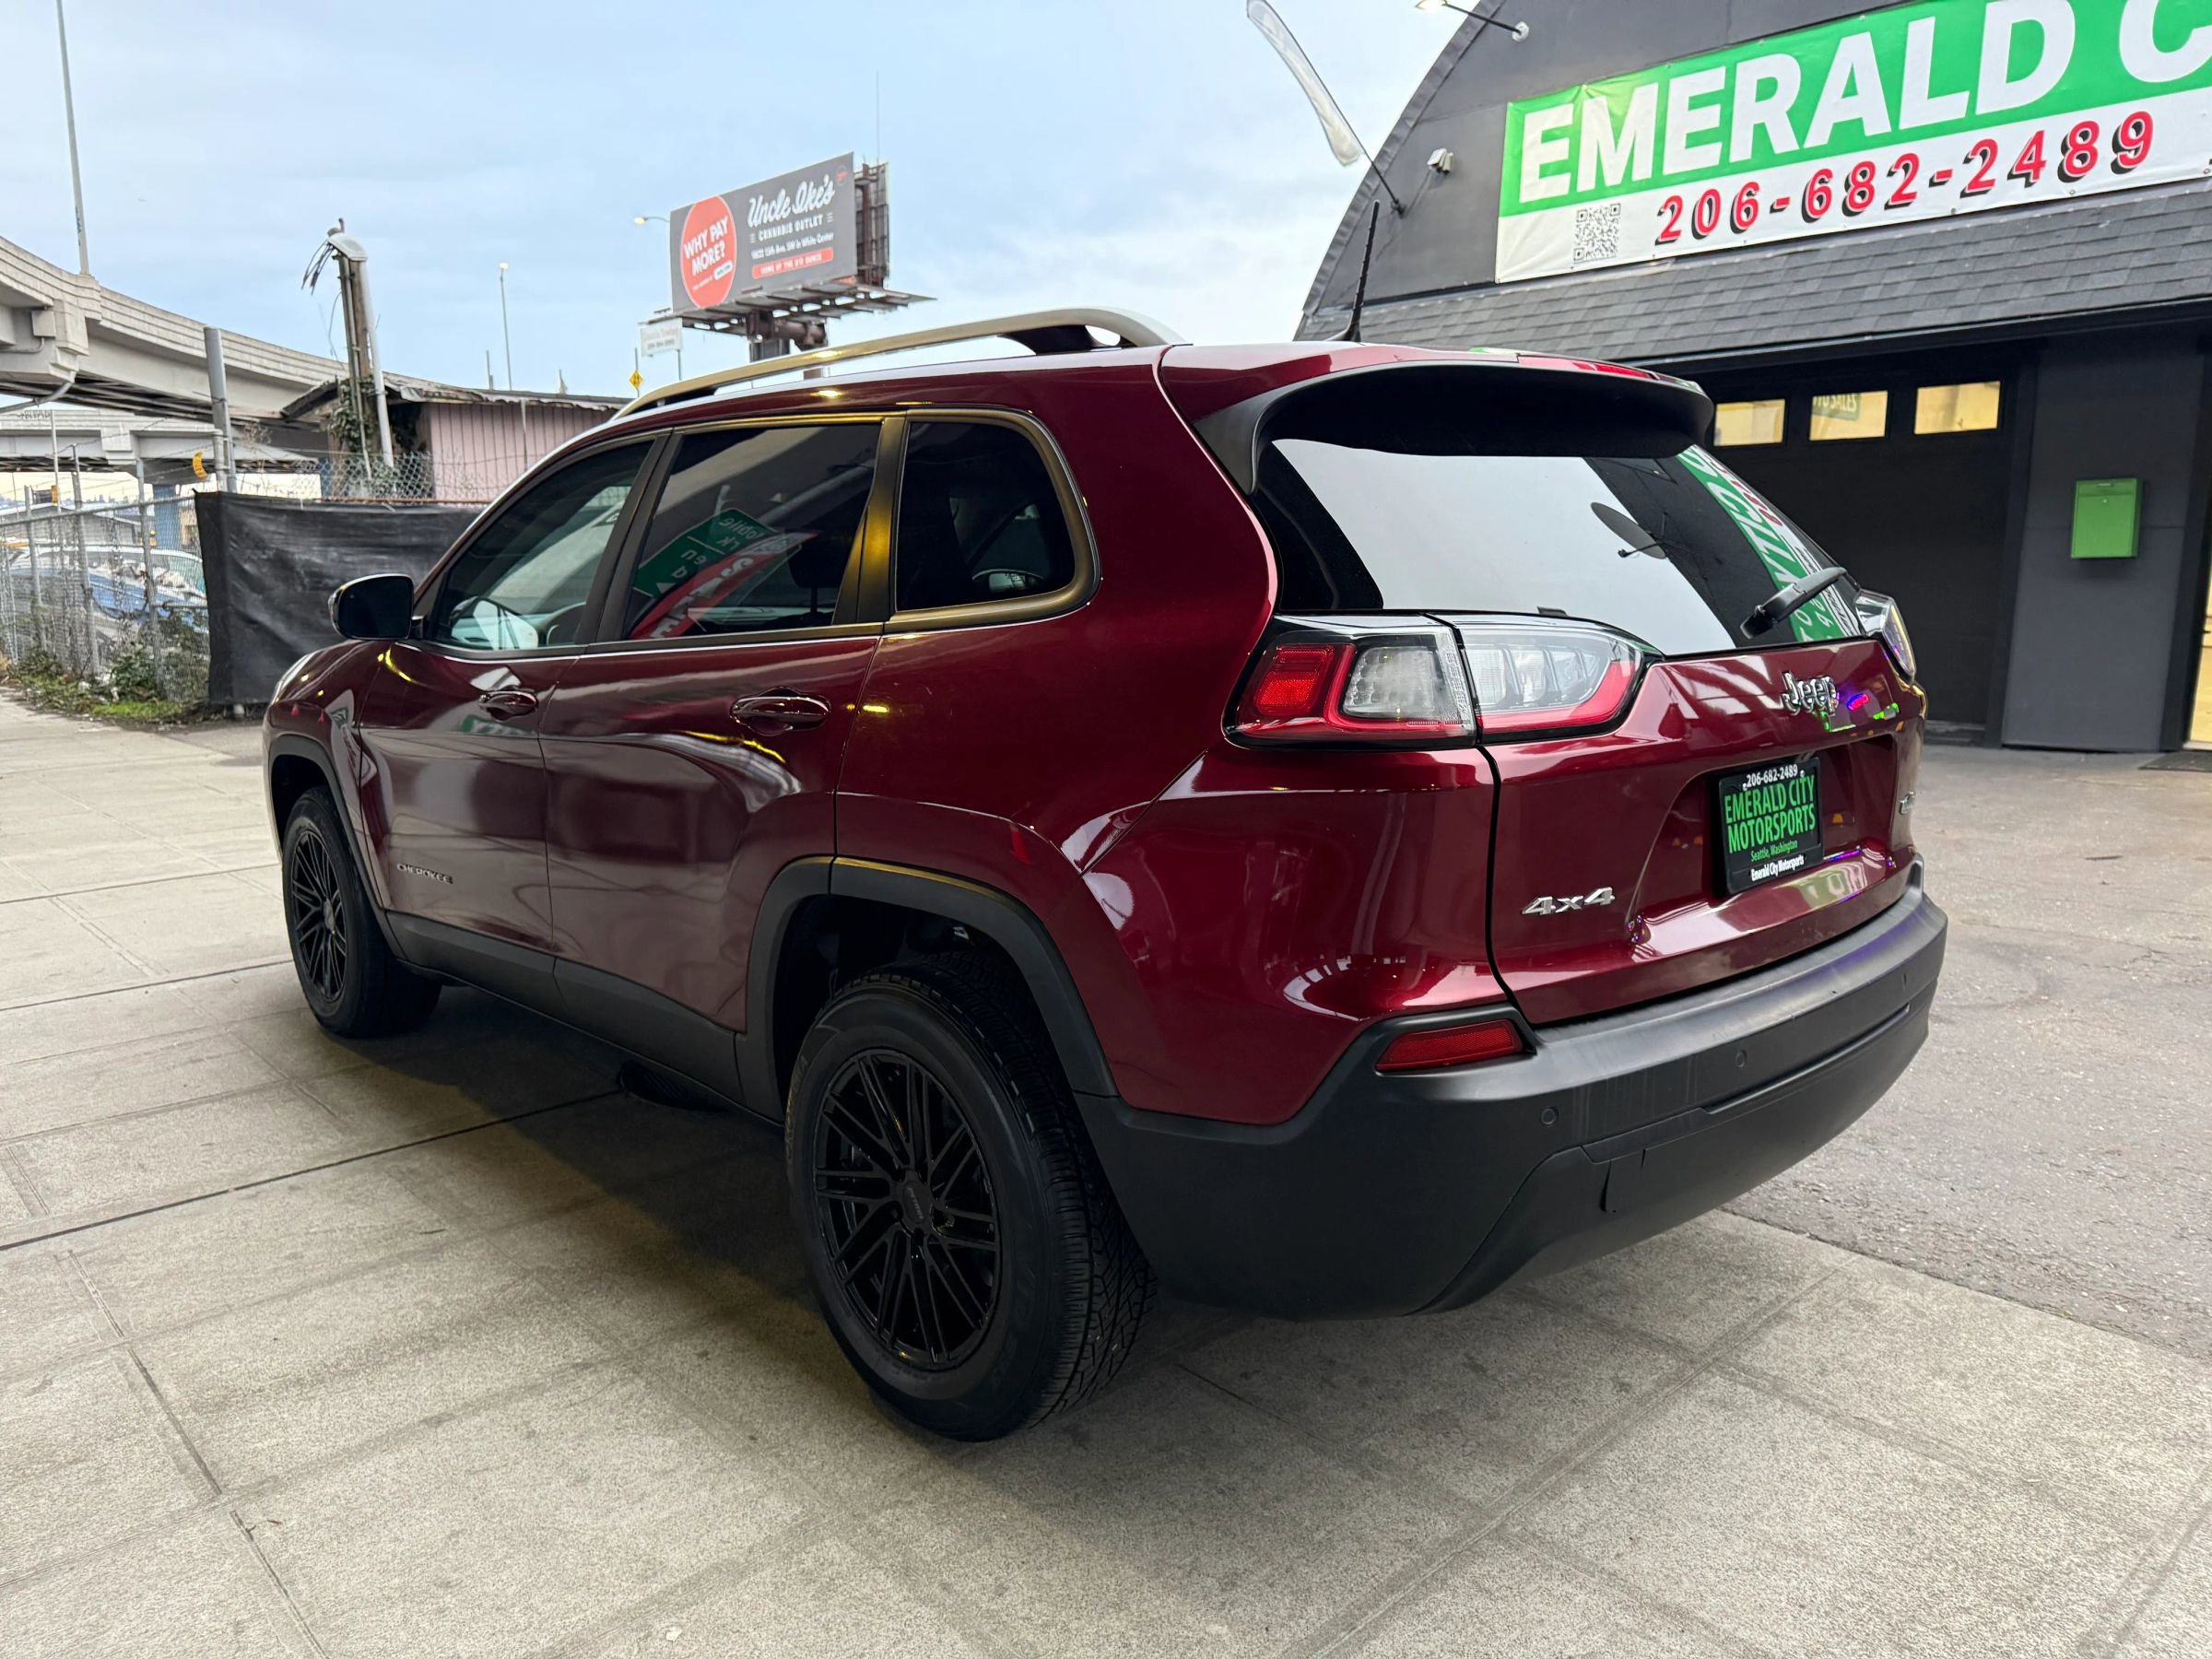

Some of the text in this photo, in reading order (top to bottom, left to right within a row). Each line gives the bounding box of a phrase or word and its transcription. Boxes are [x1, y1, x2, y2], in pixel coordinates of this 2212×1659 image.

[1519, 0, 2075, 203] EMERALD
[1655, 111, 2153, 245] 206-682-2489
[747, 174, 835, 228] Uncle Ike's
[683, 216, 728, 259] WHY PAY
[758, 214, 823, 241] CANNABIS OUTLET
[692, 240, 725, 276] MORE?
[1781, 671, 1840, 716] Jeep
[1747, 764, 1798, 788] 206-682-2489
[1724, 775, 1815, 824] EMERALD CITY
[1727, 804, 1816, 853] MOTORSPORTS
[1771, 840, 1798, 856] Washington
[1751, 854, 1805, 881] Emerald City Motorsports
[1521, 886, 1616, 915] 4x4
